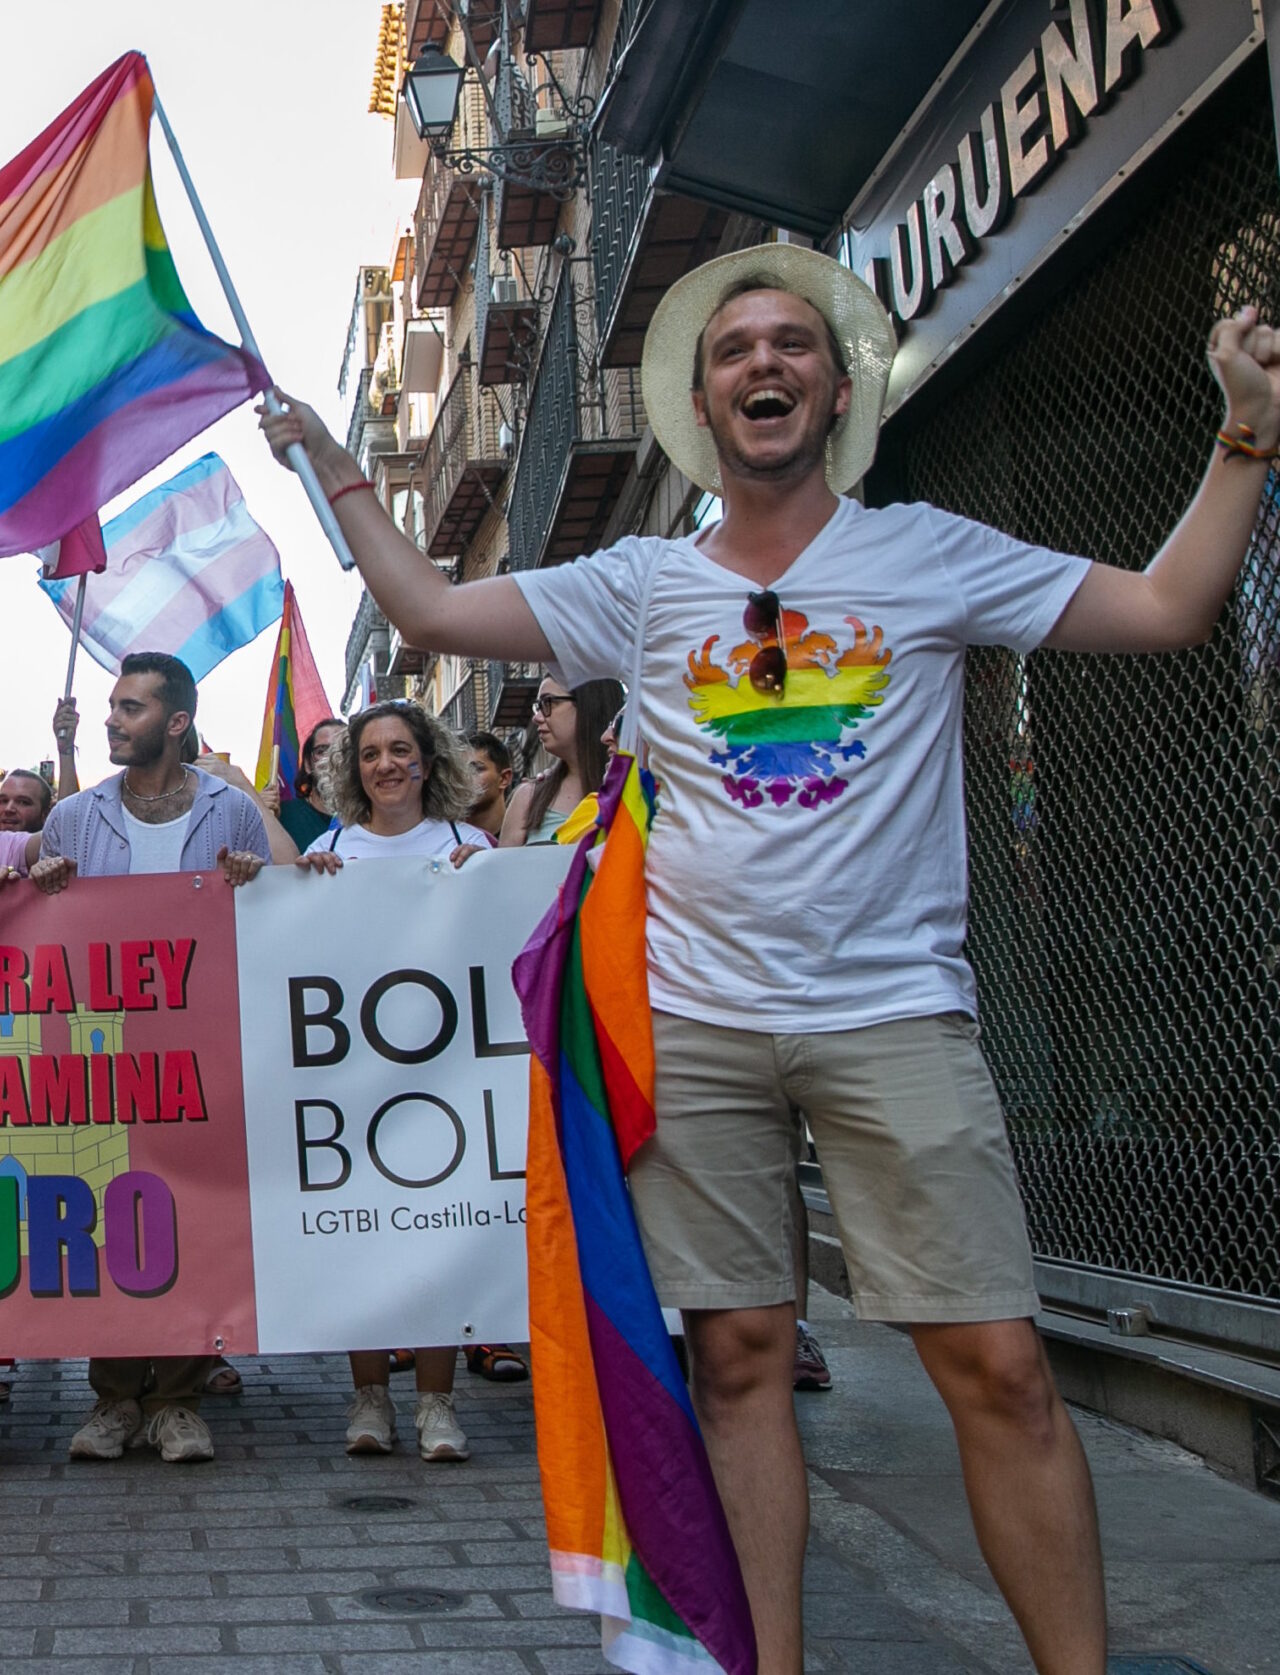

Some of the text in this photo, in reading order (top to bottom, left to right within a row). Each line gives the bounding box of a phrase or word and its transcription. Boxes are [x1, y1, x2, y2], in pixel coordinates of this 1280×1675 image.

[87, 938, 197, 1013] LEY
[288, 965, 531, 1068] BOL
[294, 1089, 528, 1193] BOL
[302, 1208, 379, 1235] LGTBI
